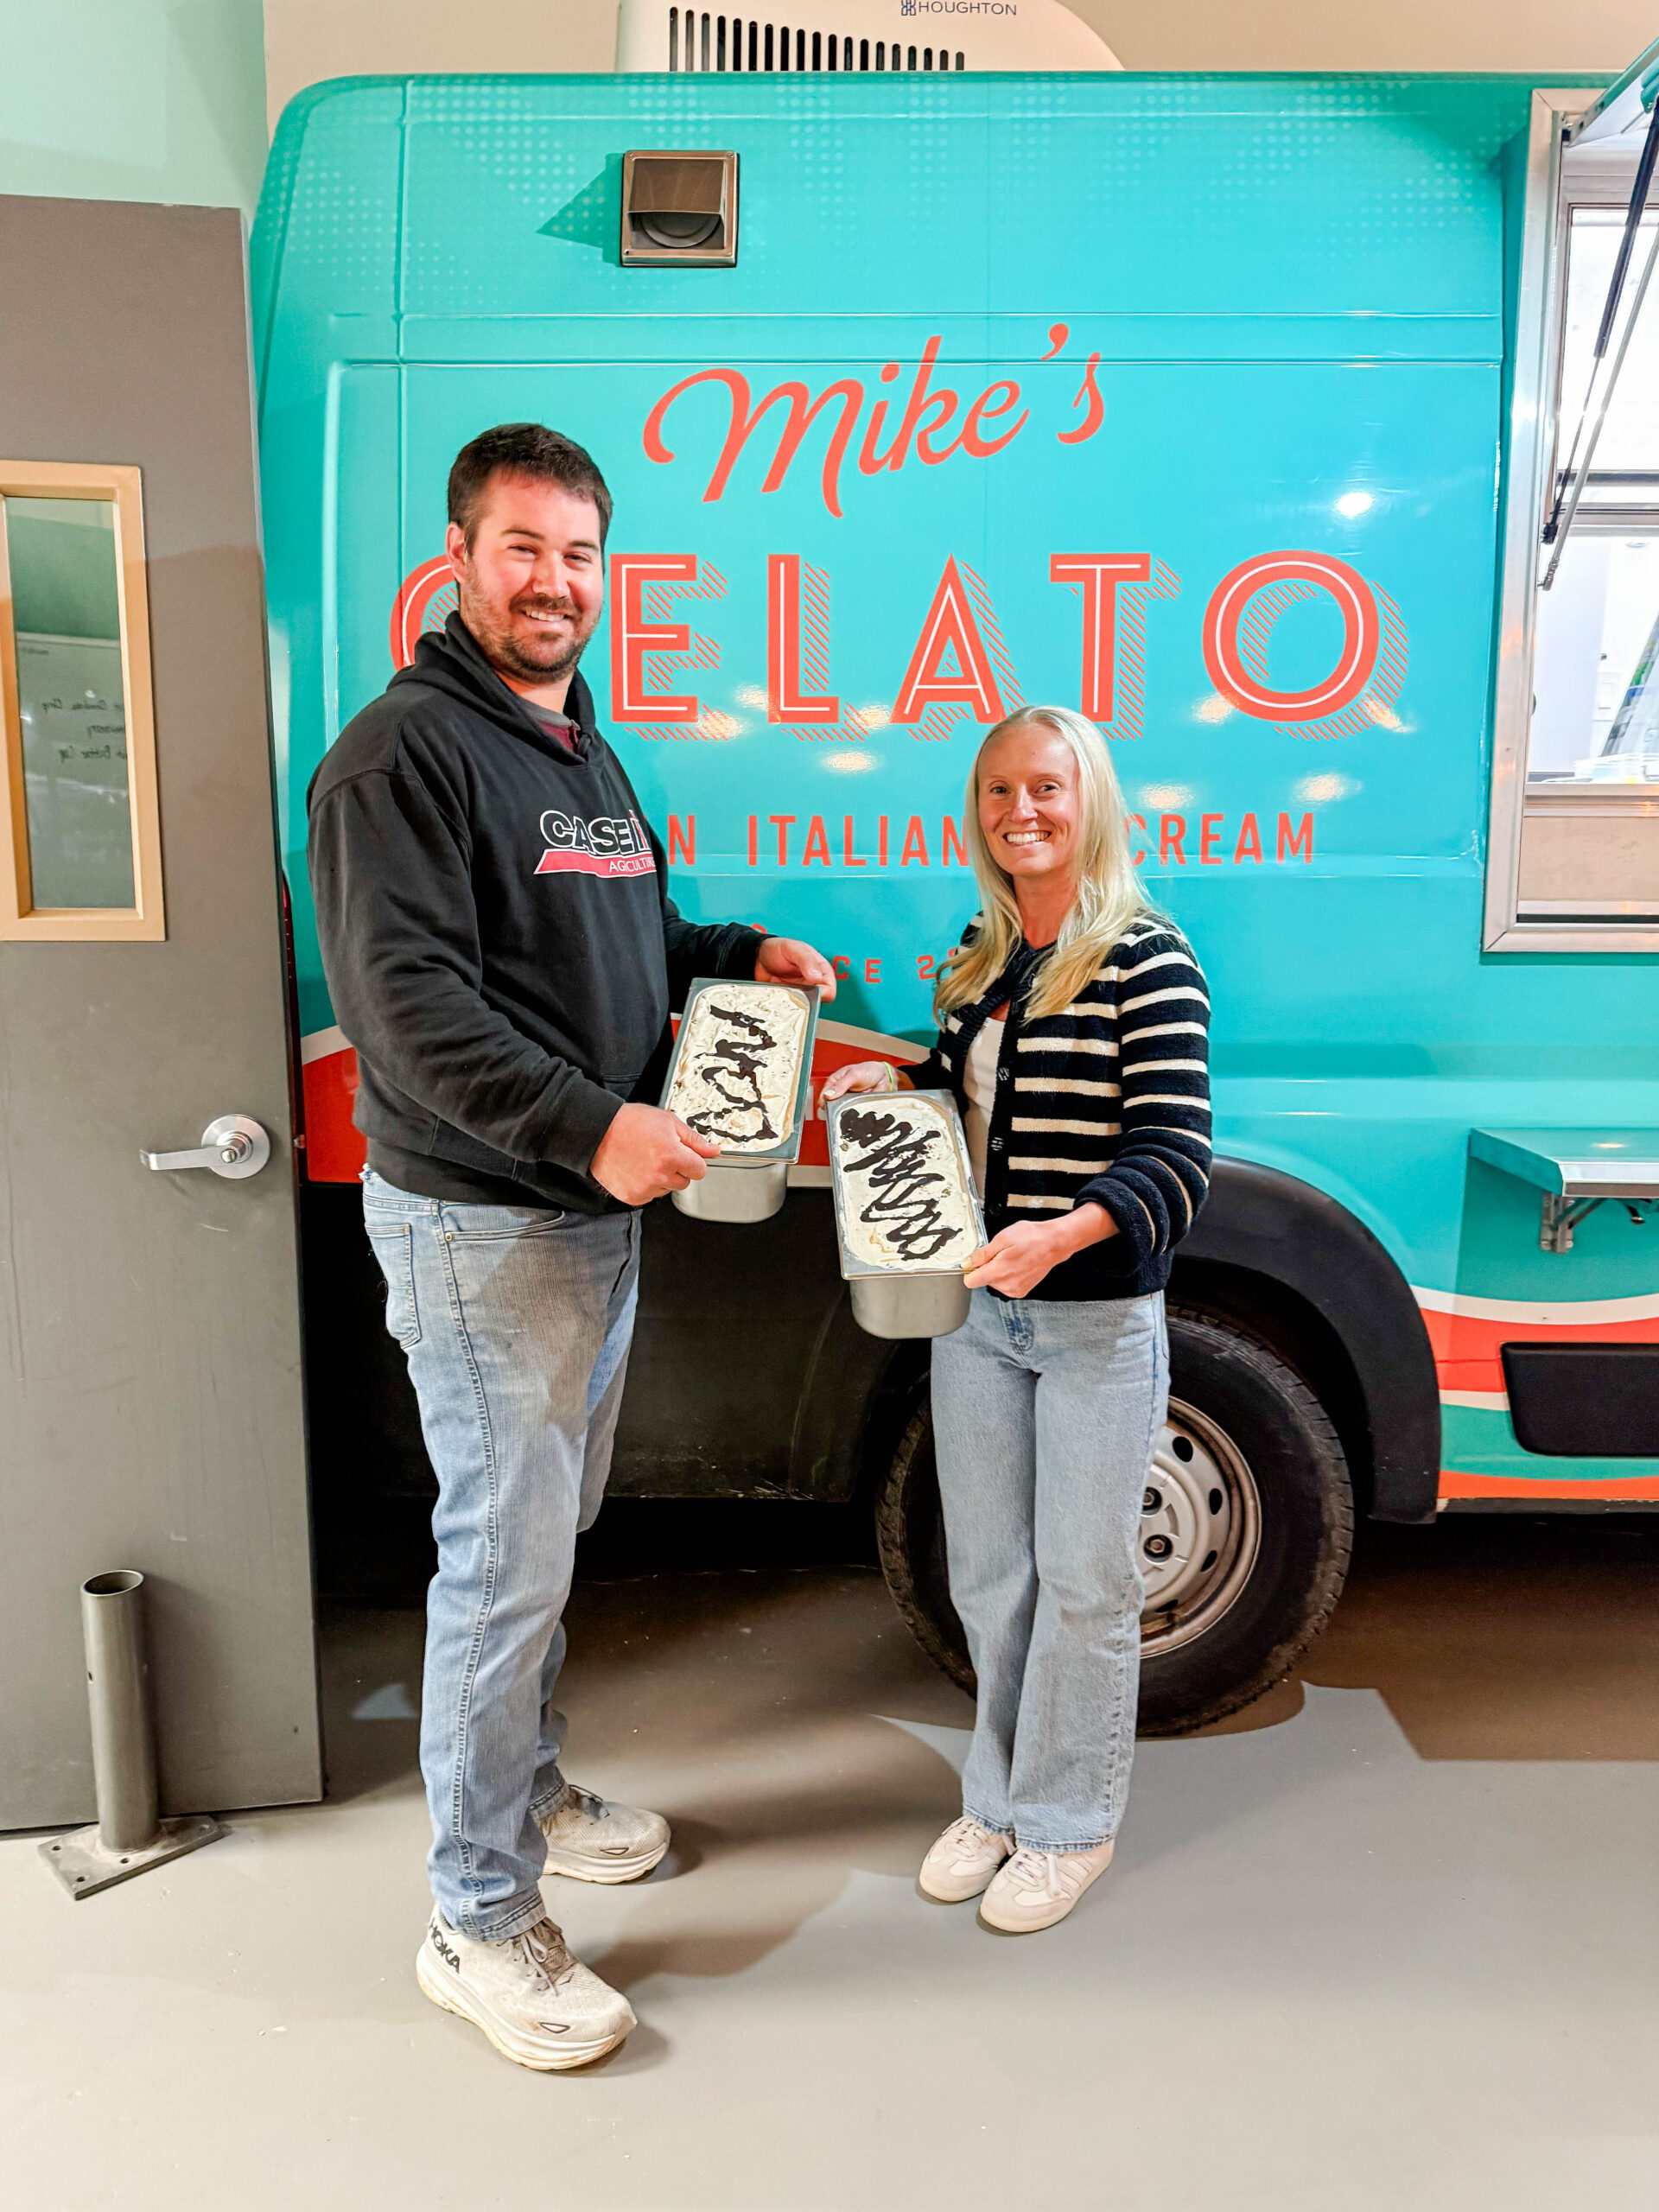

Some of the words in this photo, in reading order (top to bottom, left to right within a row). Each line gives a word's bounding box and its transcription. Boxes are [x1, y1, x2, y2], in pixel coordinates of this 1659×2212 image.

[918, 1, 1017, 16] HOUGHTON
[642, 322, 1105, 519] Mike's
[391, 550, 1408, 741] ELATO
[747, 815, 969, 867] ITALIAN
